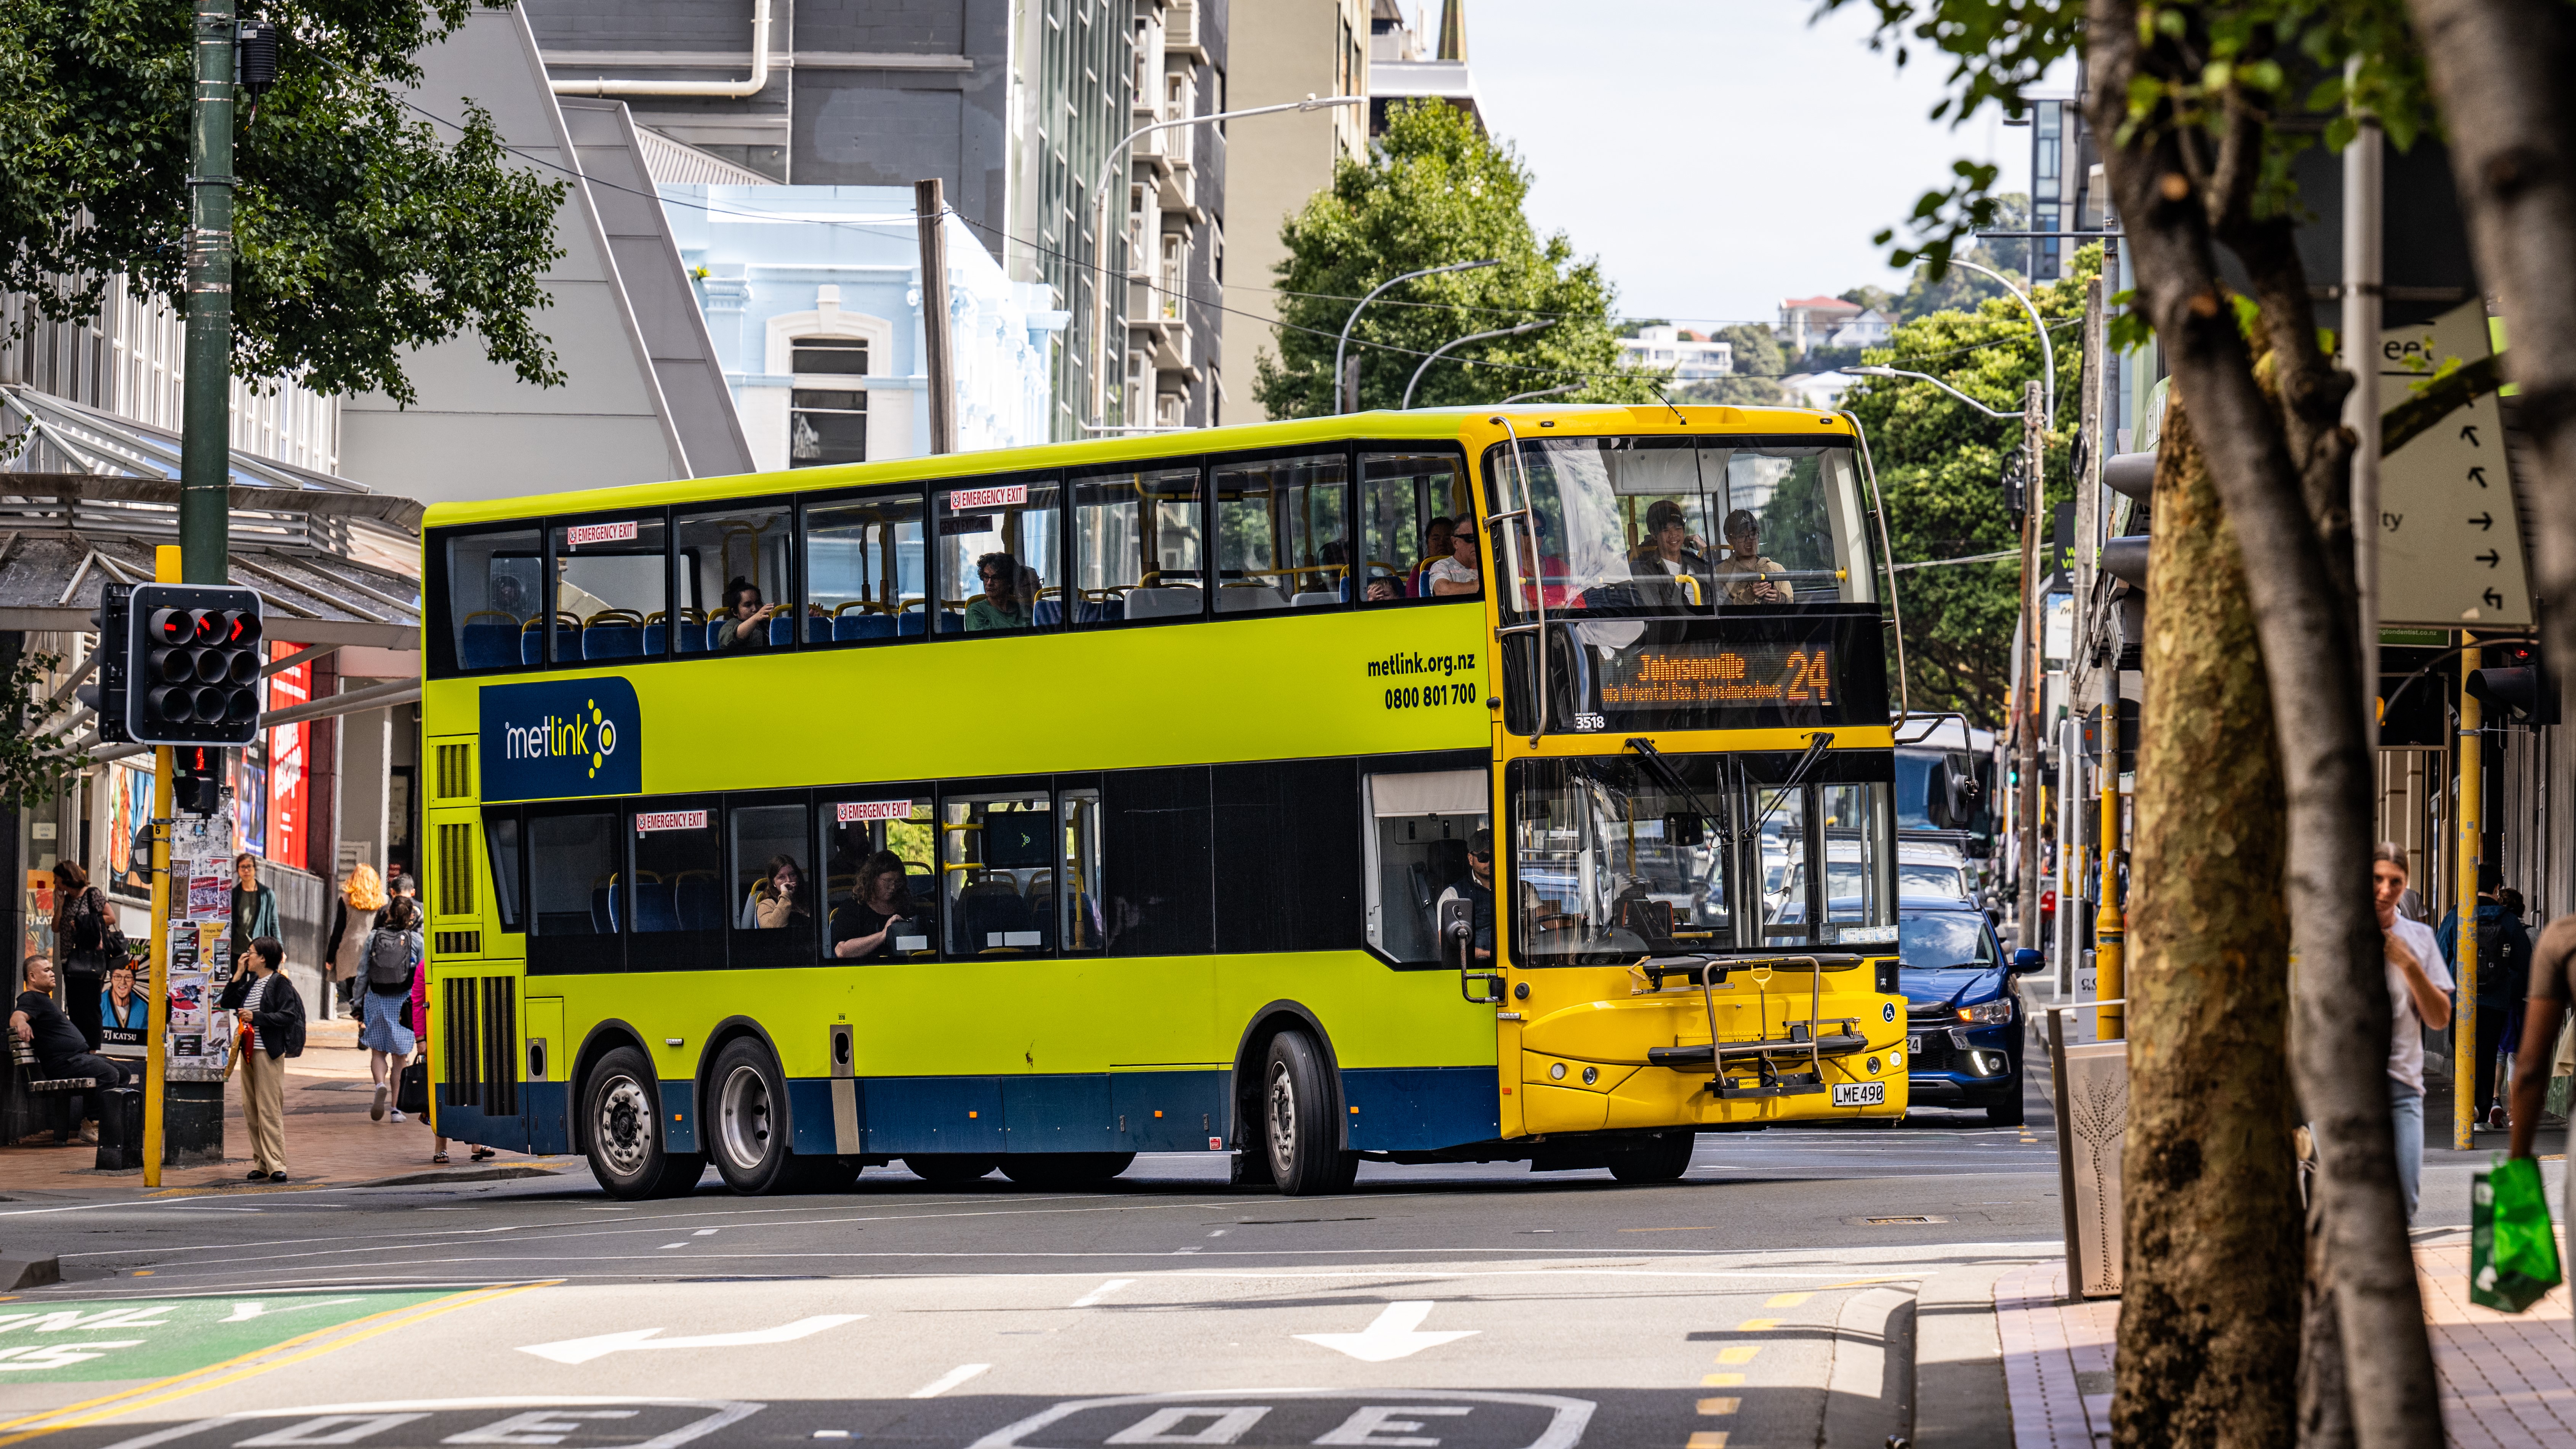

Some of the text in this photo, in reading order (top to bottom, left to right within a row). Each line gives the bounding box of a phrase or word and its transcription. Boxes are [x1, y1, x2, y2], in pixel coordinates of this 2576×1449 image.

[963, 487, 1022, 506] EMERGENCY EXIT
[578, 524, 633, 542] EMERGENCY EXIT
[1368, 652, 1475, 677] metlink.org.nz
[1638, 651, 1828, 699] Johnsonville 24
[1385, 683, 1476, 710] 0800 801 700
[1576, 716, 1605, 729] 3518
[507, 714, 589, 759] metlink
[849, 802, 907, 819] EMERGENCY EXIT
[647, 812, 702, 829] EMERGENCY EXIT
[155, 825, 160, 835] 6
[36, 916, 53, 926] KAT
[103, 1030, 137, 1041] TJ KATSU
[1835, 1085, 1883, 1103] LME490
